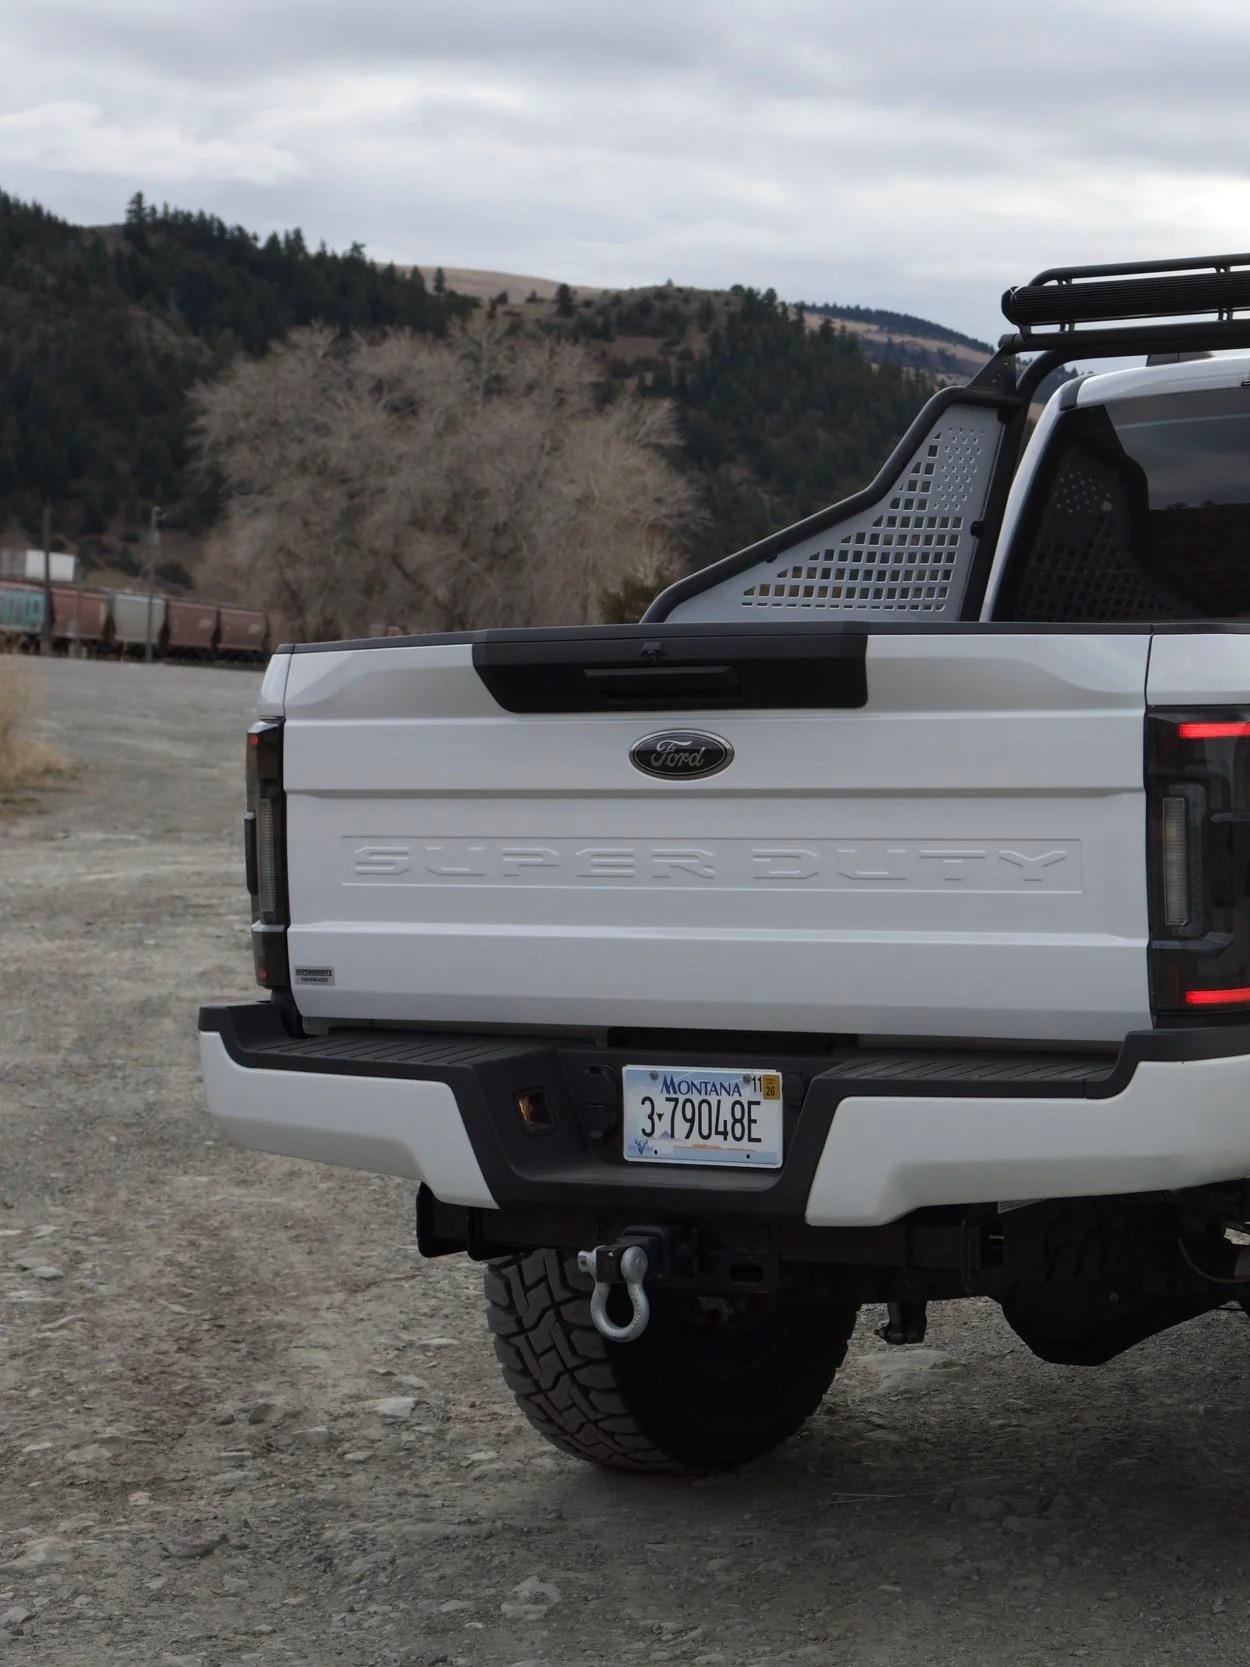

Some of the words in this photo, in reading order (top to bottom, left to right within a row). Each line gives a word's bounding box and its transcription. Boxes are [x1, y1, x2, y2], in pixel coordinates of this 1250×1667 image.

[651, 740, 706, 767] Ford
[354, 846, 716, 880] SUPER
[752, 848, 1067, 882] DUTY
[752, 1075, 762, 1092] 11
[766, 1086, 776, 1097] 26
